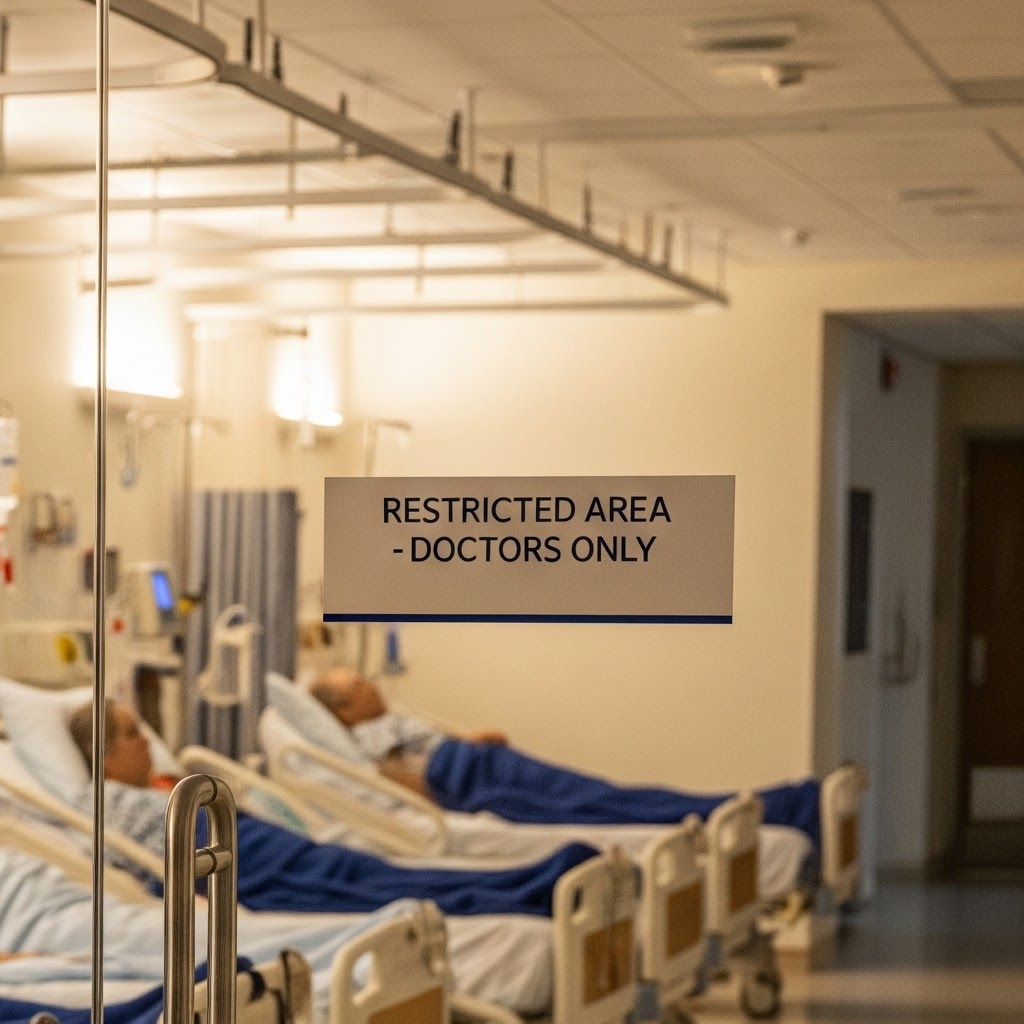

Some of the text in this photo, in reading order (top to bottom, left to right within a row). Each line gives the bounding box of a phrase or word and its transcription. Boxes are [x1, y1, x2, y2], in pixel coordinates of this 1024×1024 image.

[383, 496, 672, 524] RESTRICTED AREA
[571, 535, 657, 563] ONLY
